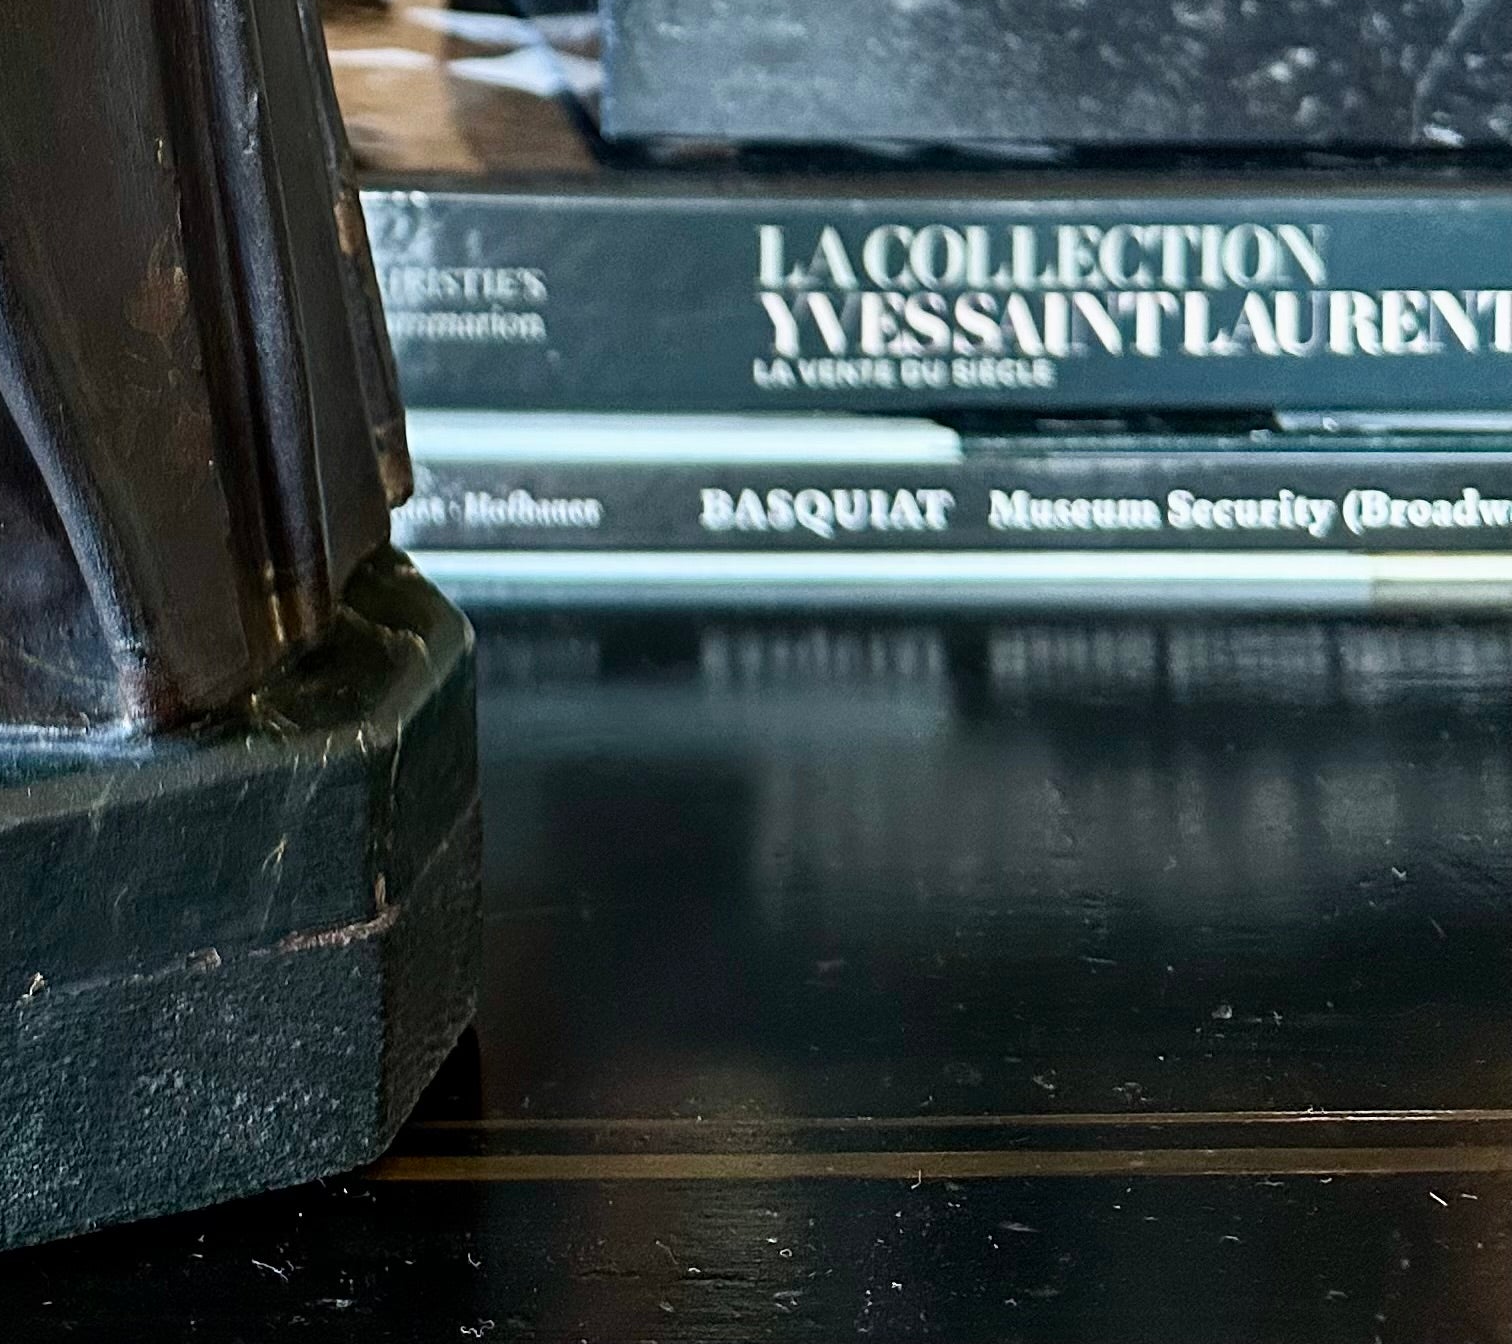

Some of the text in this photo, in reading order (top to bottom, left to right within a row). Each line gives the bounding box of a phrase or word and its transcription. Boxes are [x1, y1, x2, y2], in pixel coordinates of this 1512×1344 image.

[698, 487, 956, 540] BASQUIAT
[989, 488, 1162, 531] Museum
[1168, 488, 1337, 539] Security
